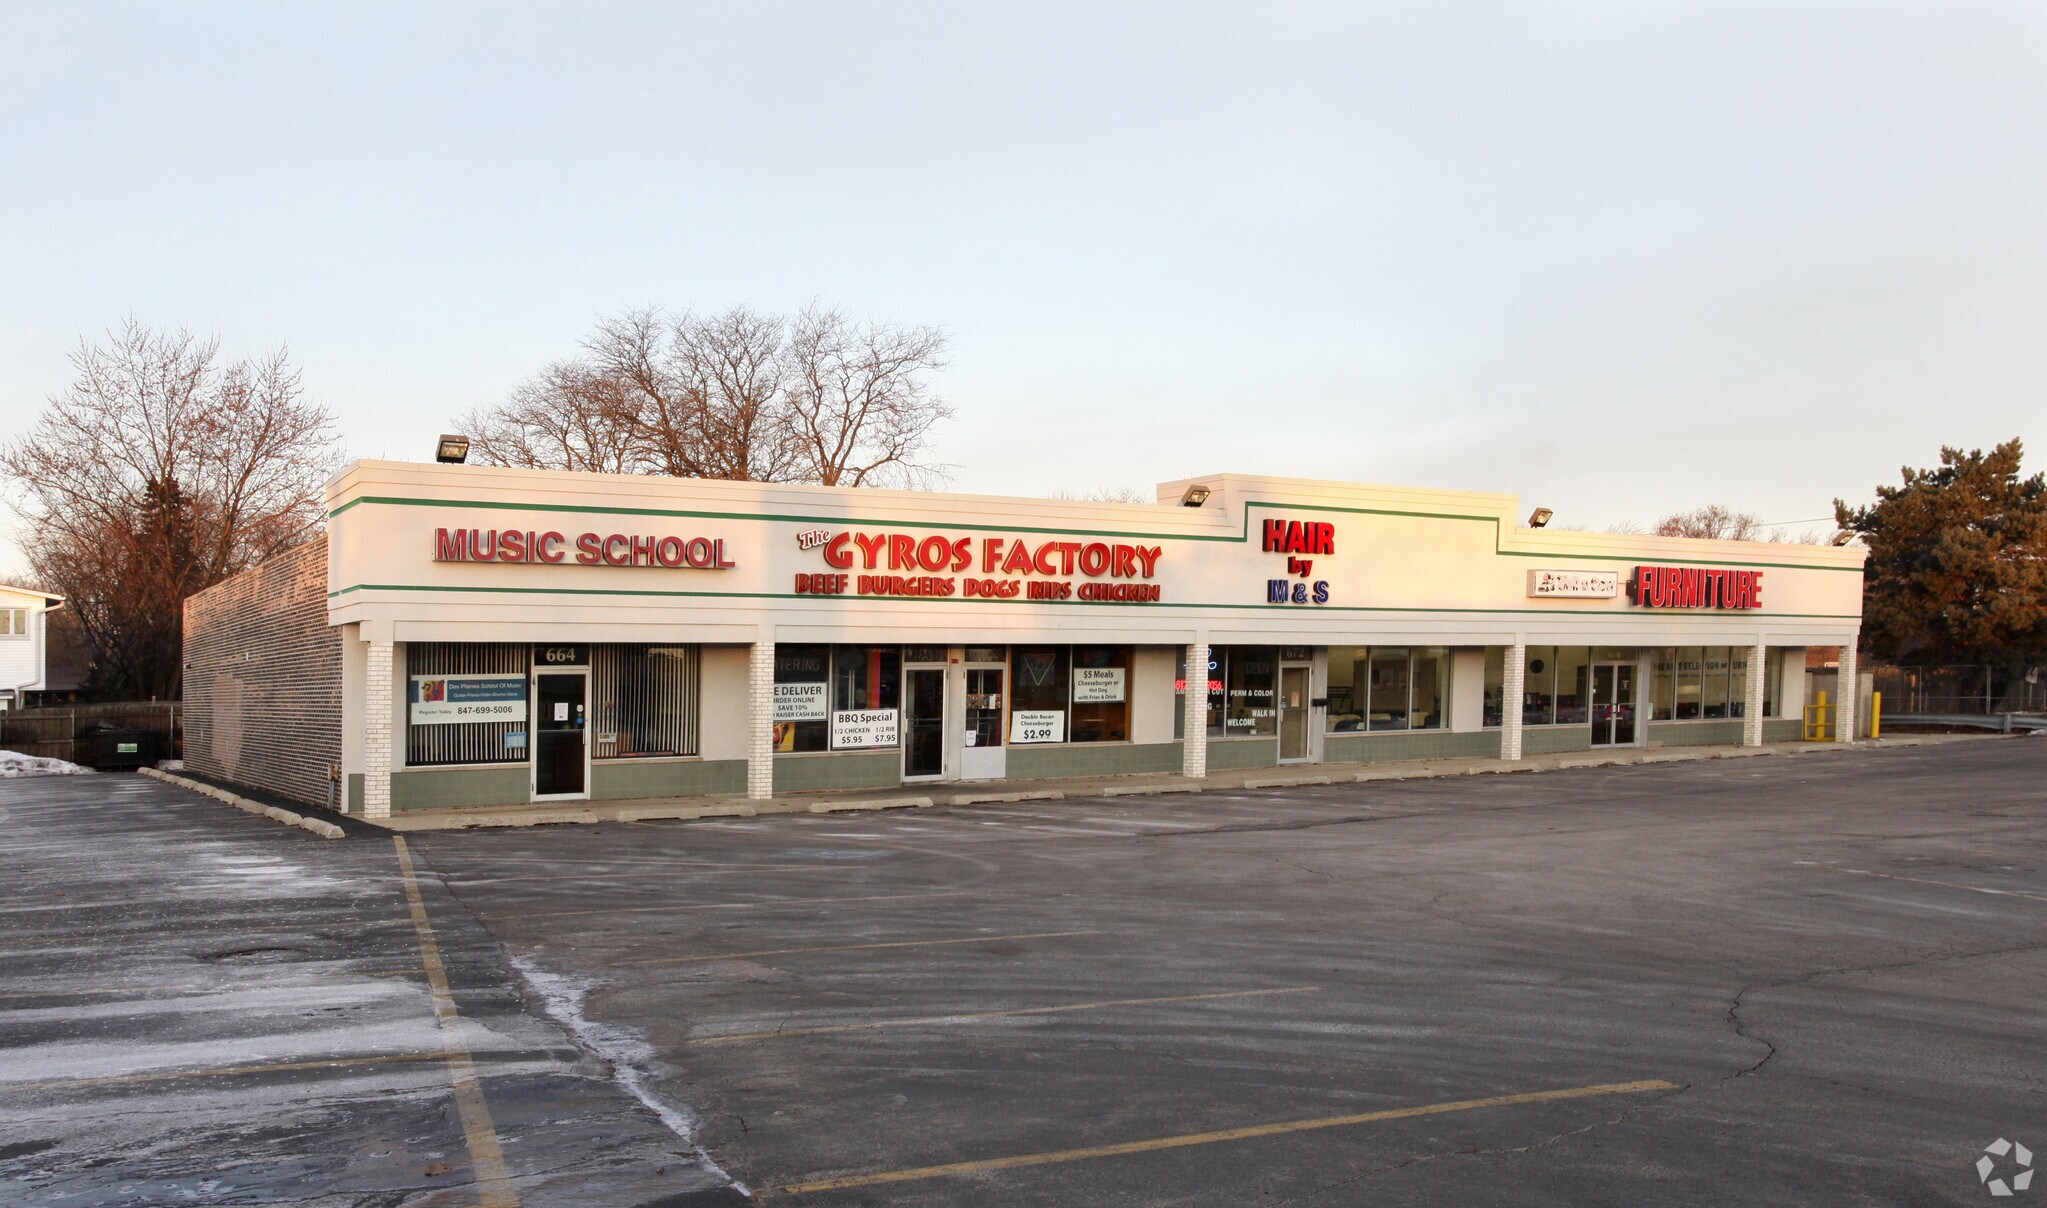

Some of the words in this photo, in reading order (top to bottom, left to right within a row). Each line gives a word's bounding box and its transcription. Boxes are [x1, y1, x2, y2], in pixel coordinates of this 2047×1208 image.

[1262, 519, 1335, 555] HAIR
[435, 527, 565, 564] MUSIC
[576, 532, 736, 568] SCHOOL
[799, 528, 831, 549] The
[824, 531, 972, 573] GYROS
[983, 537, 1163, 578] FACTORY
[1288, 556, 1313, 577] by
[795, 573, 849, 594] BEEF
[857, 574, 955, 597] BURGERS
[963, 577, 1021, 598] DOGS
[1027, 581, 1072, 600] RIBS
[1077, 582, 1161, 602] CHICKEN
[1267, 579, 1288, 603] M
[1291, 583, 1308, 604] &
[1312, 580, 1329, 604] S
[1635, 566, 1763, 609] FURNITURE
[546, 648, 576, 661] 664
[1287, 648, 1304, 658] 672
[774, 658, 820, 671] TERING
[1084, 670, 1092, 679] $5
[1093, 670, 1114, 679] Meals
[782, 686, 822, 696] DELIVER
[457, 705, 513, 715] 847-699-5006
[1252, 709, 1267, 717] WALK
[1269, 709, 1276, 717] IN
[839, 713, 858, 723] BBQ
[860, 712, 893, 724] Special
[1227, 718, 1256, 727] WELCOME
[841, 735, 863, 744] $5.95
[875, 734, 896, 742] $7.95
[1024, 729, 1051, 740] $2.99
